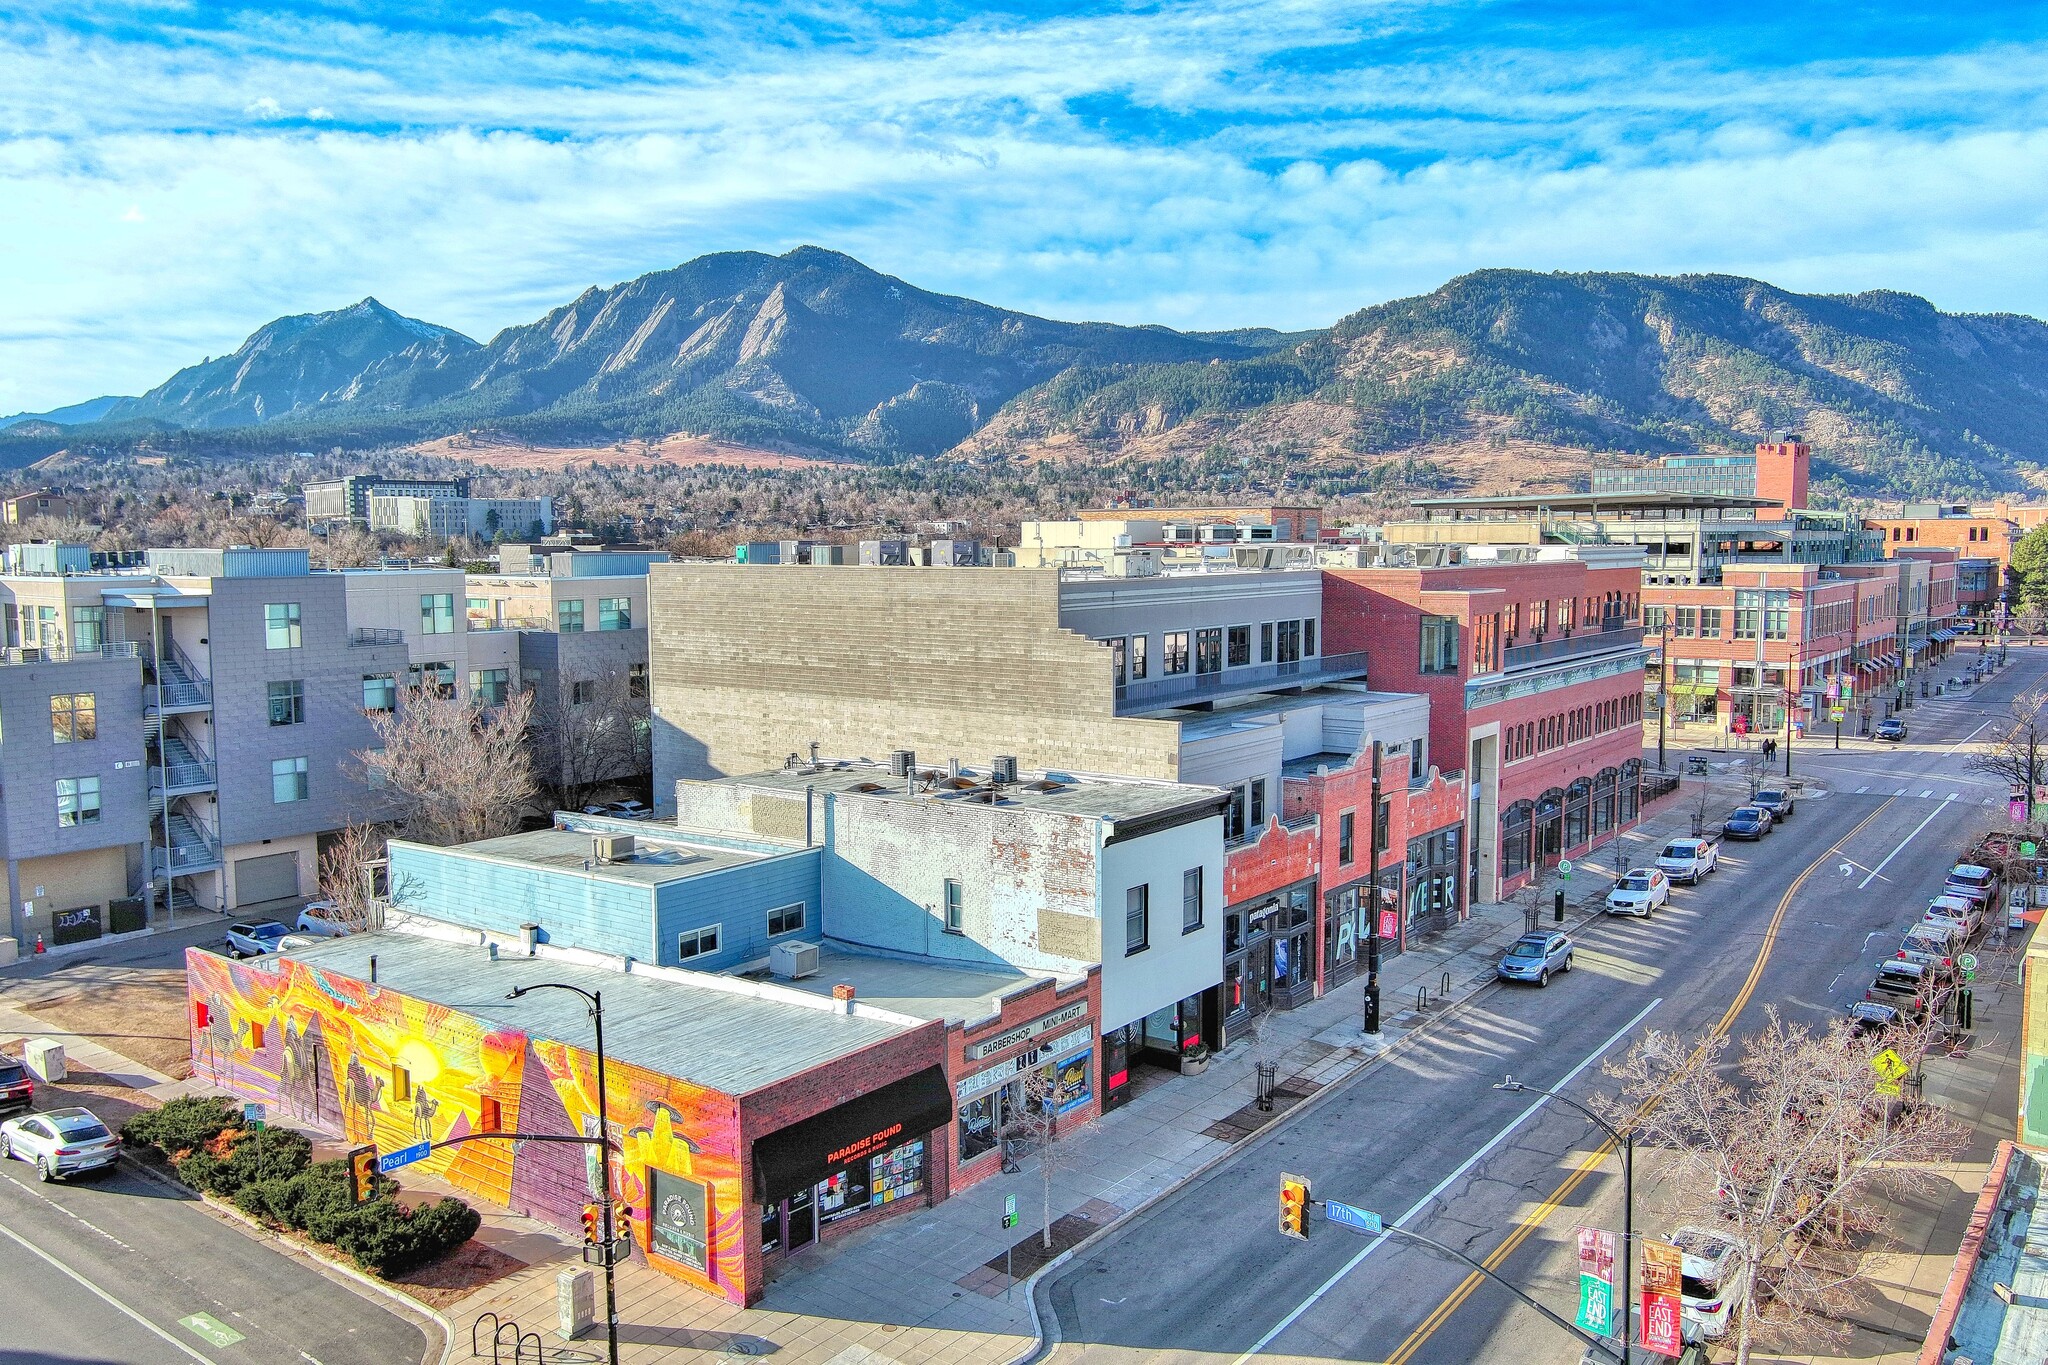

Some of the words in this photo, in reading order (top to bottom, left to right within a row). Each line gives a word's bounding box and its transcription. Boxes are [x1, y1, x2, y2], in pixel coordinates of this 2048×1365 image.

[1249, 902, 1279, 924] patagonia
[982, 1027, 1031, 1056] BARBERSHOP
[1042, 1006, 1081, 1031] MINI-MART
[827, 1136, 871, 1164] PARADISE
[872, 1123, 902, 1144] FOUND
[843, 1149, 867, 1164] RECORDS
[872, 1140, 888, 1152] MUSIC
[382, 1151, 407, 1170] Pearl
[662, 1194, 682, 1215] PARADISE
[682, 1199, 695, 1226] FOUND
[1331, 1204, 1352, 1221] 17th
[1588, 1286, 1608, 1306] EAST
[1586, 1299, 1607, 1319] END
[1649, 1305, 1673, 1323] EAST
[1648, 1318, 1673, 1338] END
